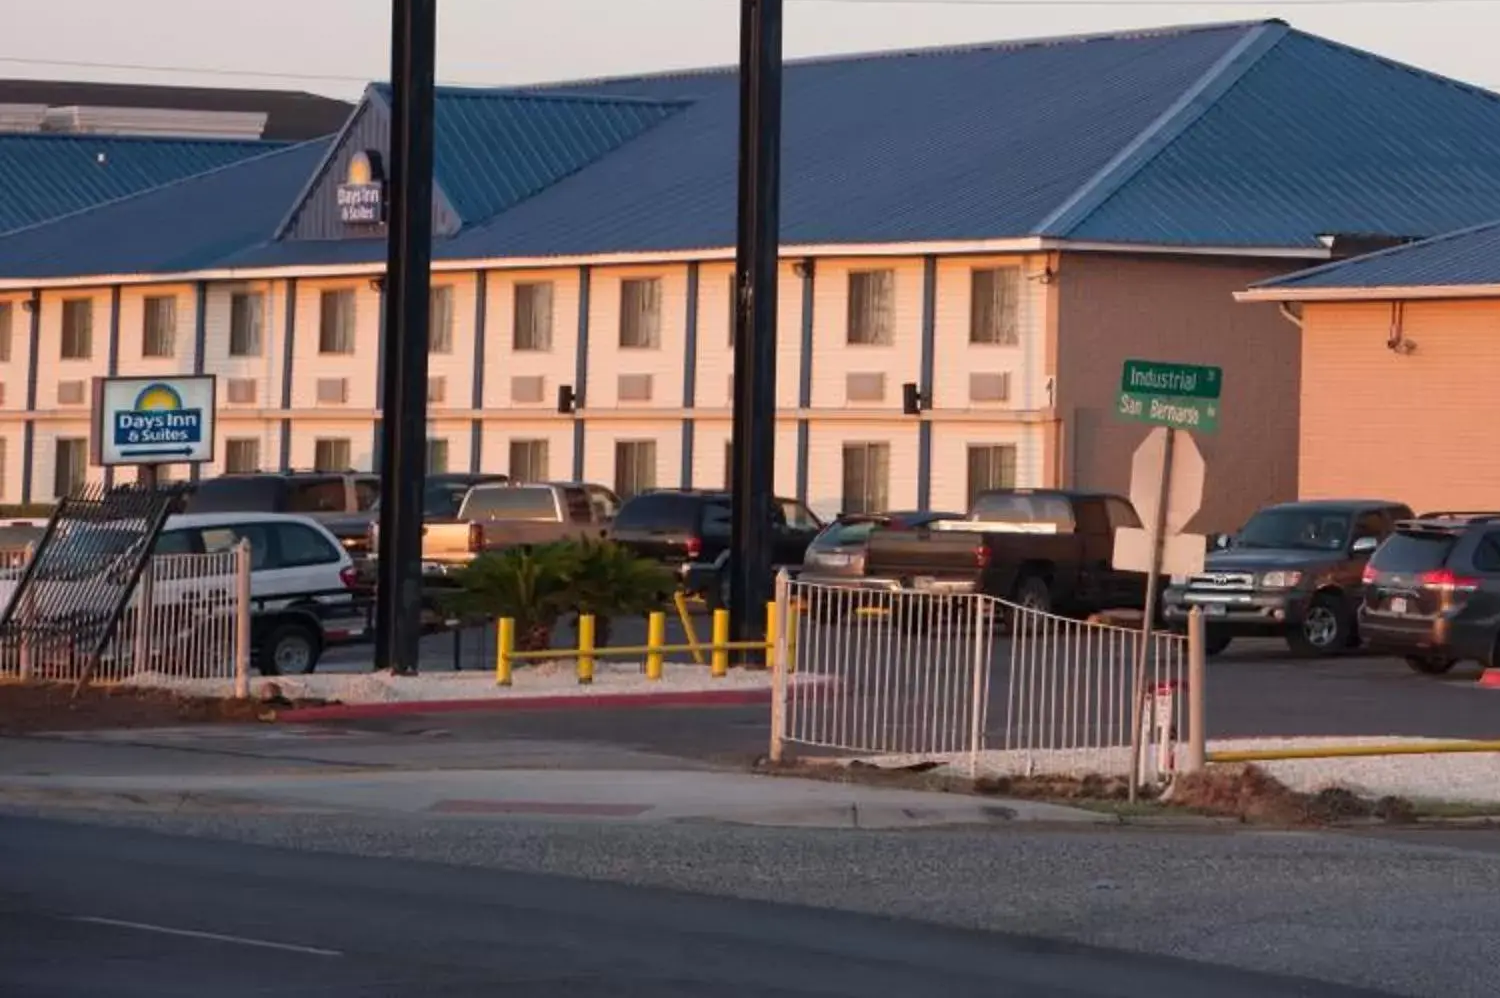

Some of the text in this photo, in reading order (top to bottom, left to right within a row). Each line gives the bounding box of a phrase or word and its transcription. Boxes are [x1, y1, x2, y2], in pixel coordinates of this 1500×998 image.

[1130, 366, 1198, 392] Industrial
[1120, 393, 1143, 415] San
[120, 414, 197, 429] Days Inn
[128, 428, 188, 442] & Suites
